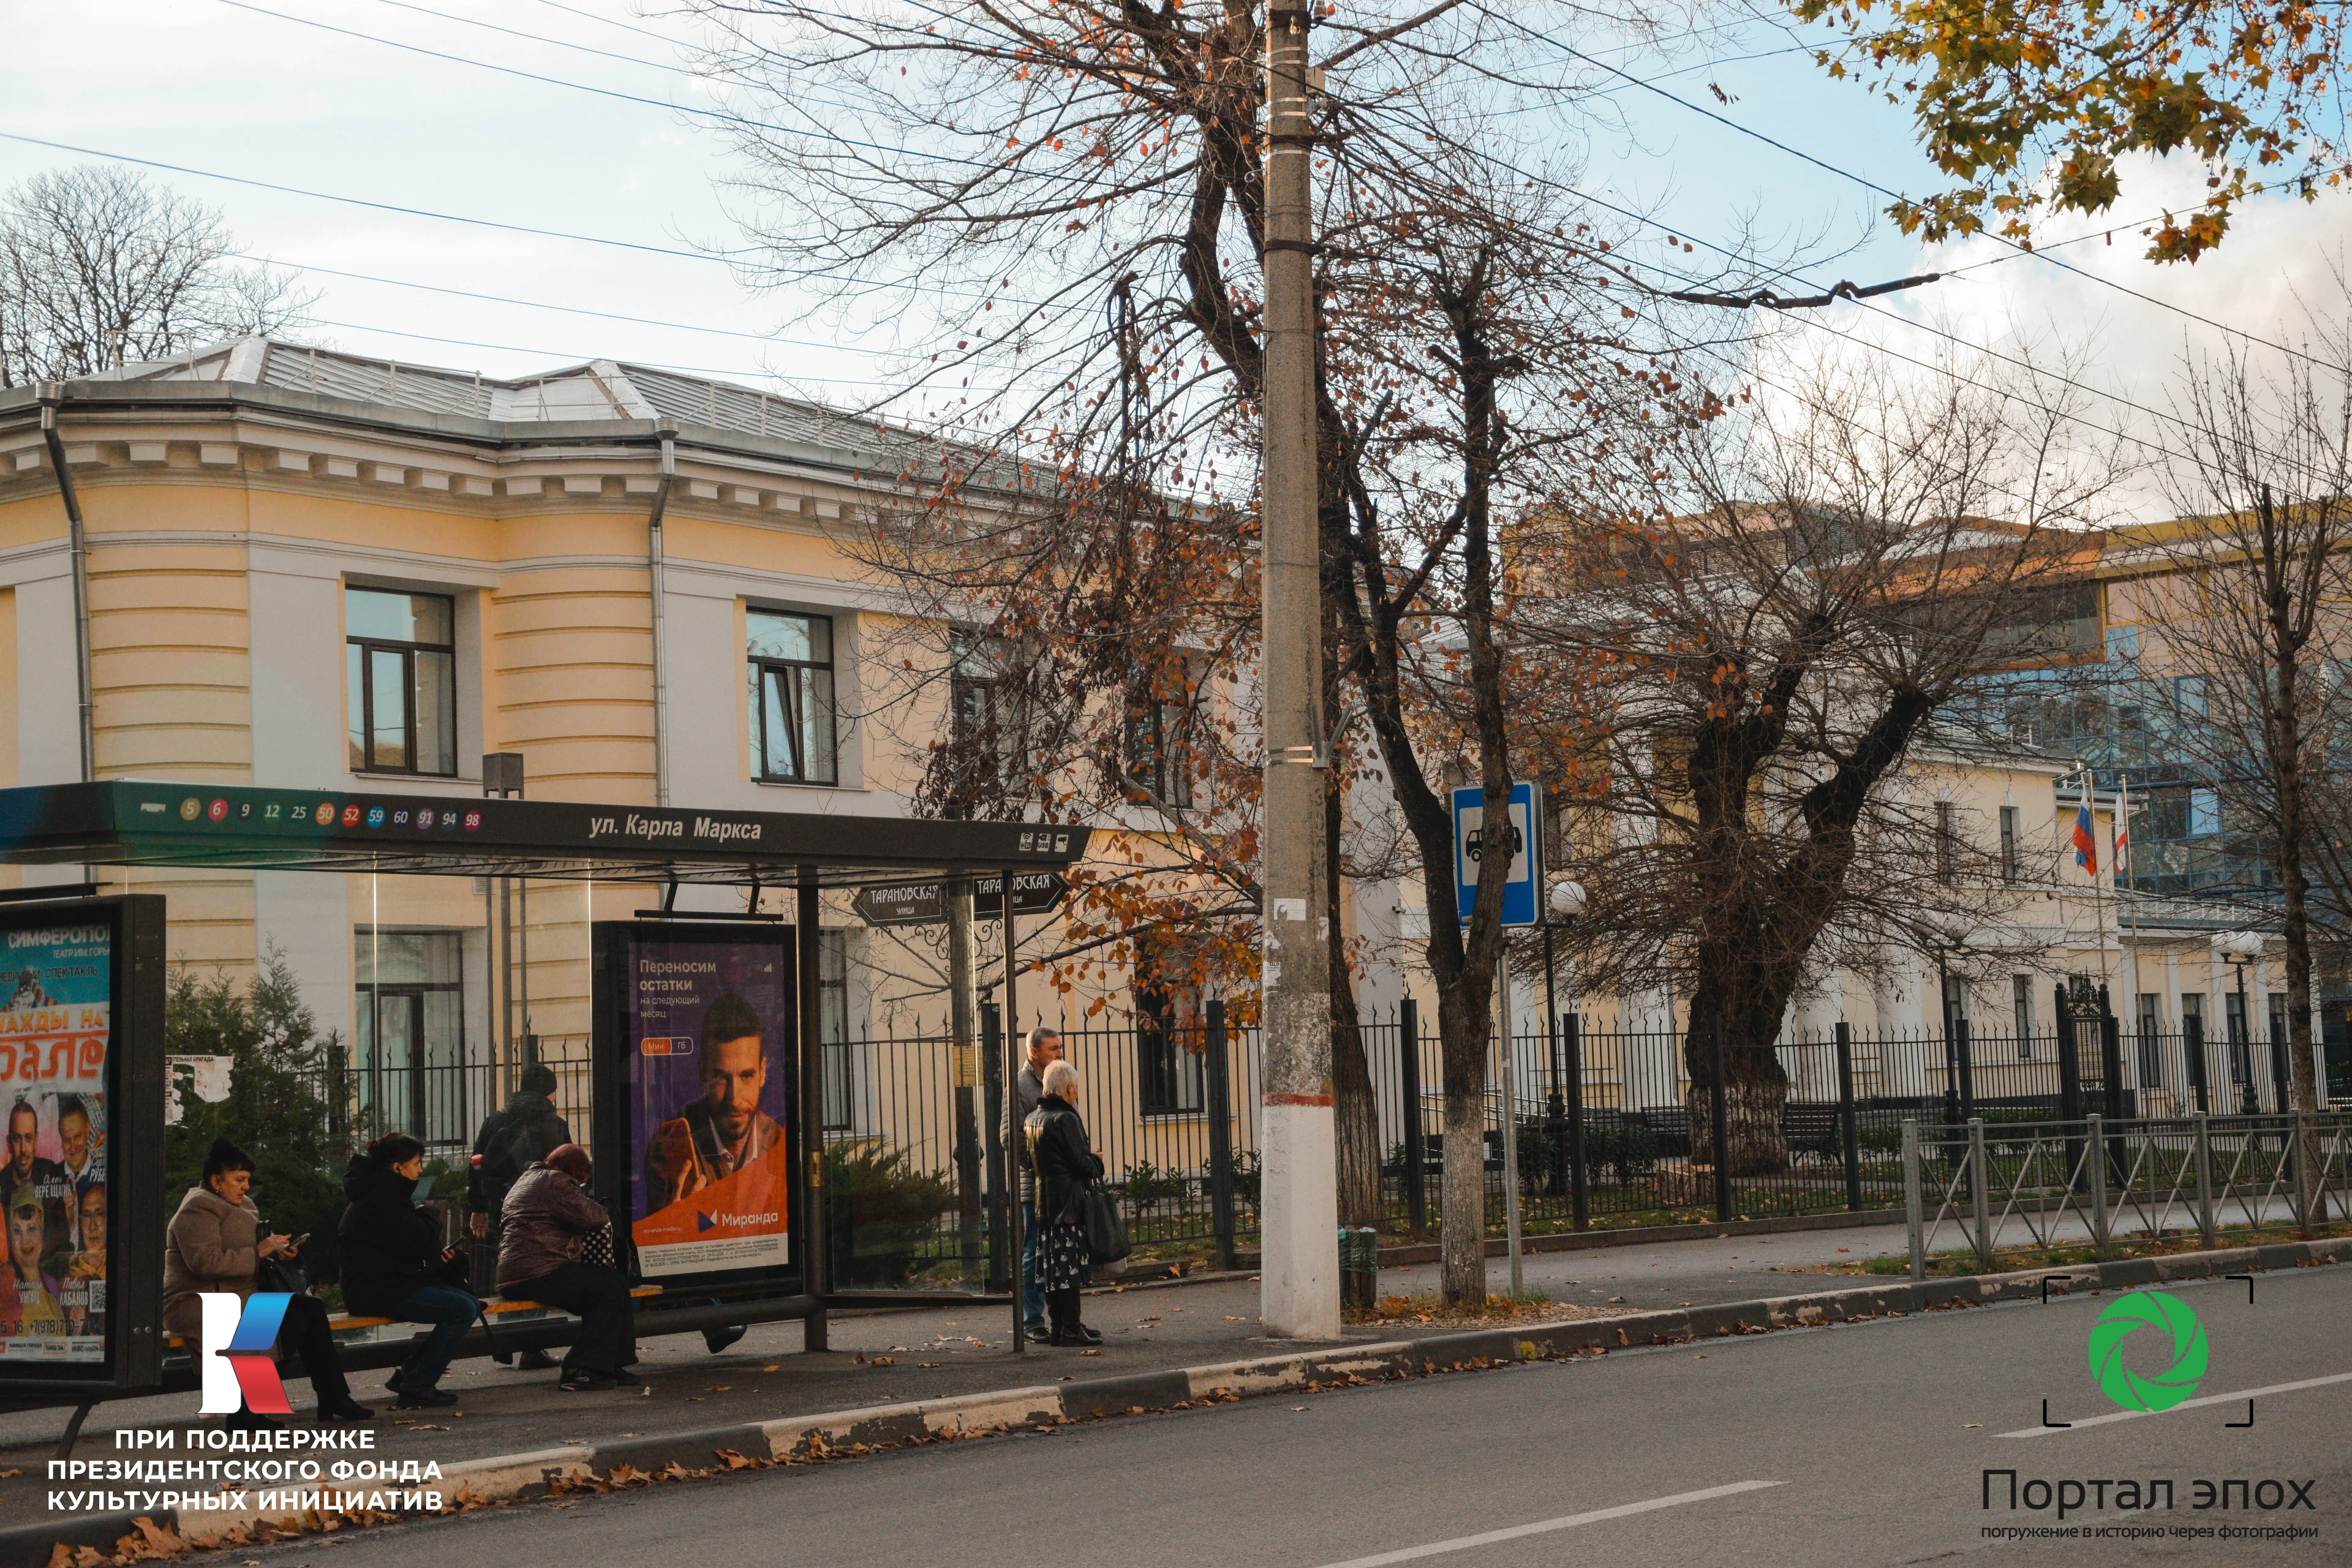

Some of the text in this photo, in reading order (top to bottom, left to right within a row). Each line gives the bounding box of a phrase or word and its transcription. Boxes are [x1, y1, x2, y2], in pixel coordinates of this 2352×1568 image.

[186, 802, 480, 826] 5 6 9 12 25 50 52 59 60 91 94 98
[589, 813, 762, 843] ул. Карла Маркса
[976, 873, 1050, 895] ТАРАВСКАЯ
[870, 884, 938, 904] ТАРАНОВСКАЯ
[896, 906, 914, 915] УЛИЦА
[45, 965, 99, 979] СПЕКТАКЛЬ
[639, 959, 716, 976] Переносим
[639, 980, 692, 991] остатки
[651, 995, 700, 1006] следующий
[80, 1008, 104, 1029] НА
[722, 1212, 778, 1229] Миранда
[62, 1276, 85, 1289] Павел
[59, 1291, 88, 1306] КАБАНОВ
